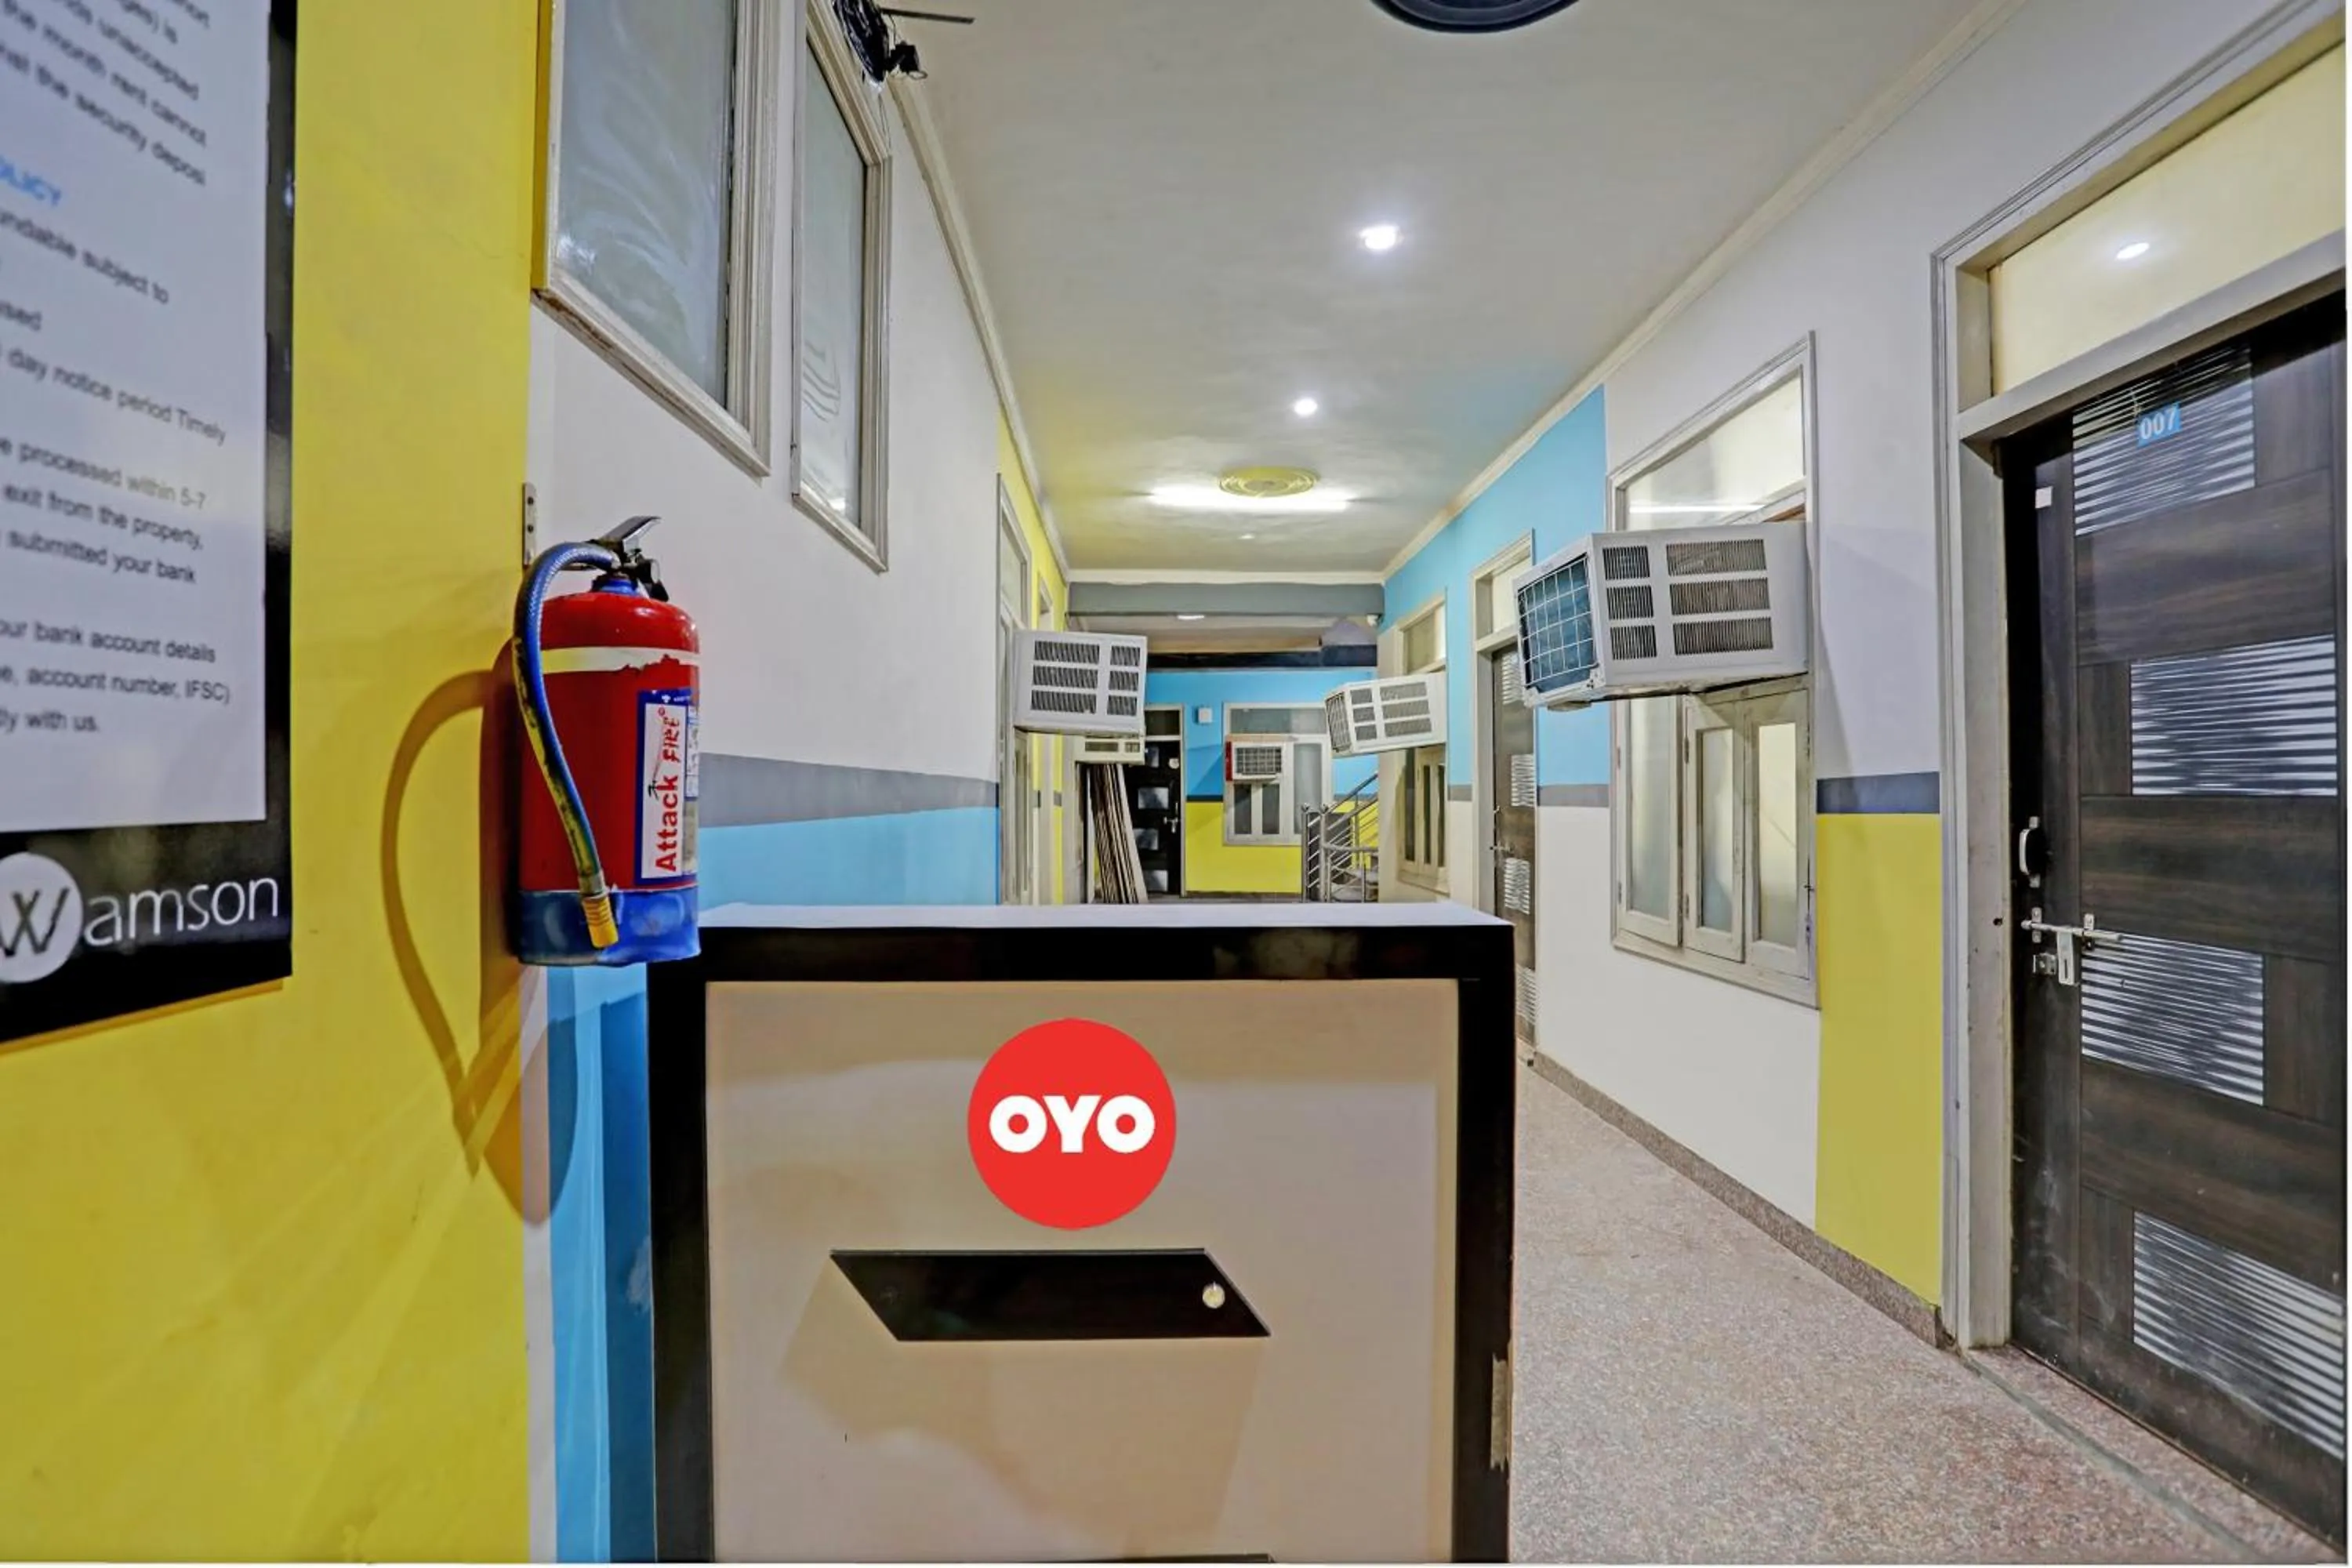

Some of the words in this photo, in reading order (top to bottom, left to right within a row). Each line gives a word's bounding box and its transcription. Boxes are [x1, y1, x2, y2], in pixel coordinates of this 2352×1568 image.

[74, 93, 147, 151] security
[82, 249, 149, 294] subject
[152, 282, 169, 304] to
[8, 349, 47, 382] day
[53, 366, 112, 401] notice
[118, 390, 172, 423] period
[176, 408, 226, 446] Timely
[2140, 406, 2177, 440] 007
[19, 442, 122, 488] processed
[125, 474, 176, 503] within
[180, 486, 205, 510] 5-7
[3, 485, 42, 510] exit
[47, 490, 93, 521] from
[97, 504, 128, 530] the
[7, 529, 107, 567] submitted
[111, 551, 152, 574] your
[156, 556, 196, 583] bank
[34, 619, 82, 645] bank
[89, 632, 161, 657] account
[165, 640, 216, 663] details
[27, 667, 107, 690] account
[185, 679, 230, 705] IFSC)
[26, 710, 67, 730] with
[662, 717, 681, 764] FIRE
[655, 775, 679, 873] Attack
